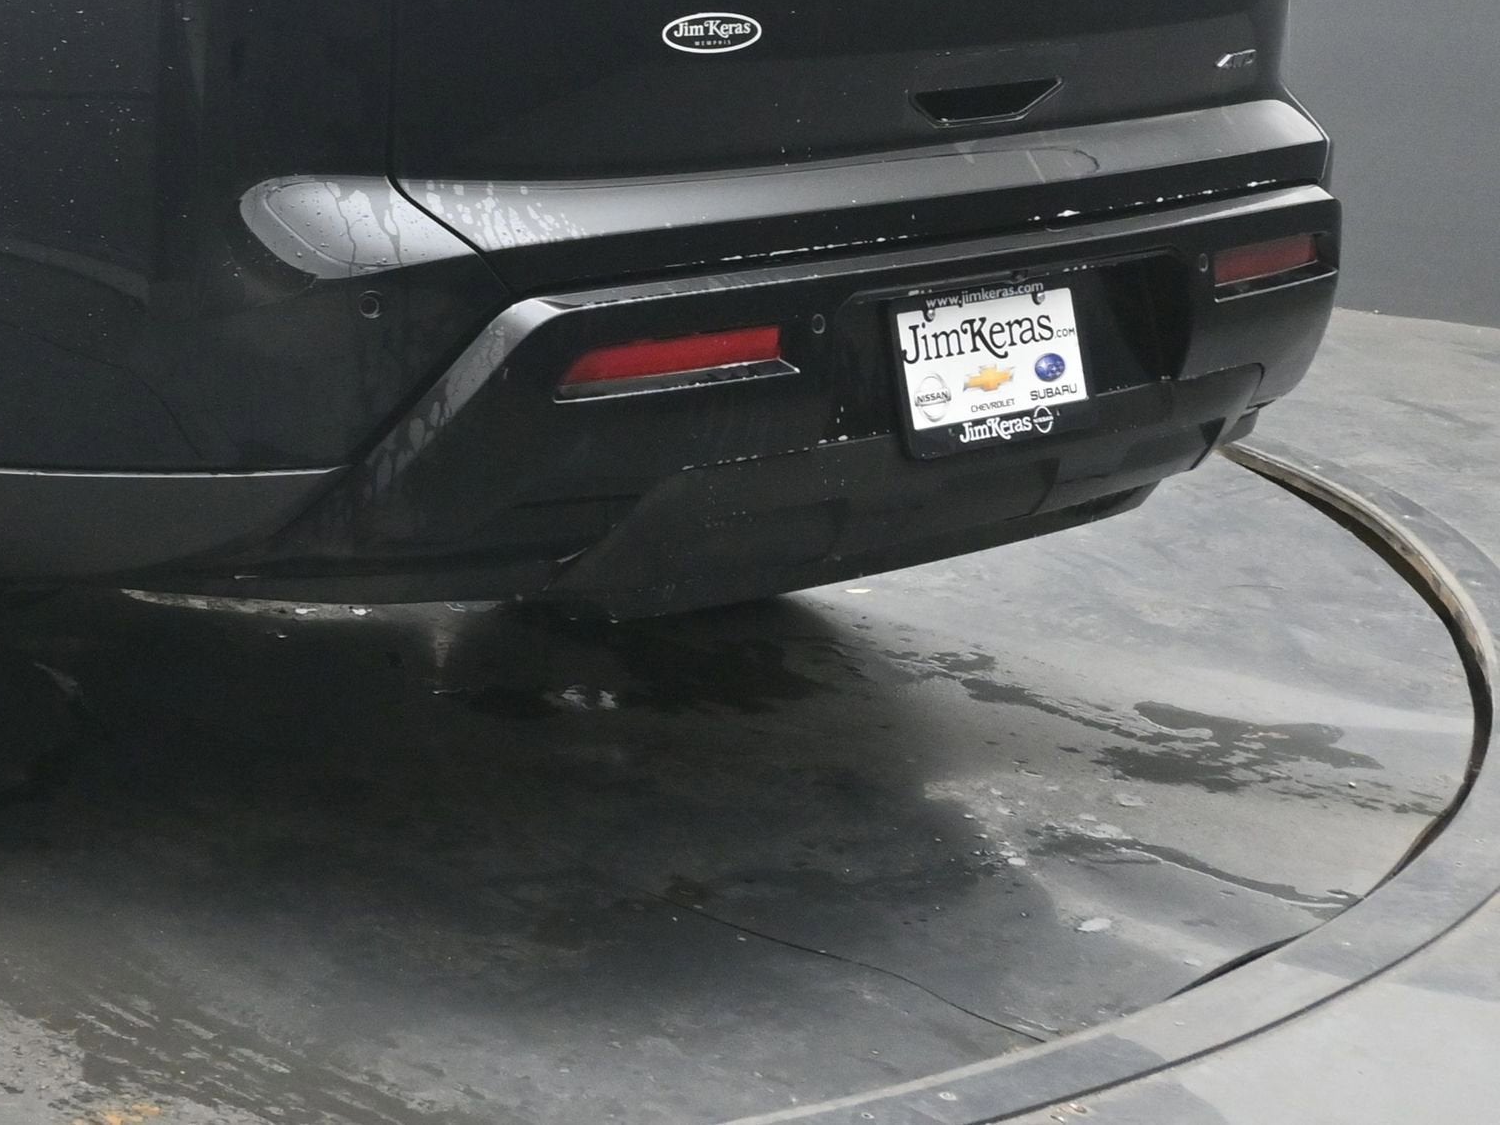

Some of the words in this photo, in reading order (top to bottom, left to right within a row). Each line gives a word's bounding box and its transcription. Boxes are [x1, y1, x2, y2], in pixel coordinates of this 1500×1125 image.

[925, 281, 1044, 309] www.jimkeras.com
[916, 389, 949, 404] NISSAN
[1030, 383, 1078, 402] SUBARU
[970, 398, 1016, 414] CHEVROLET
